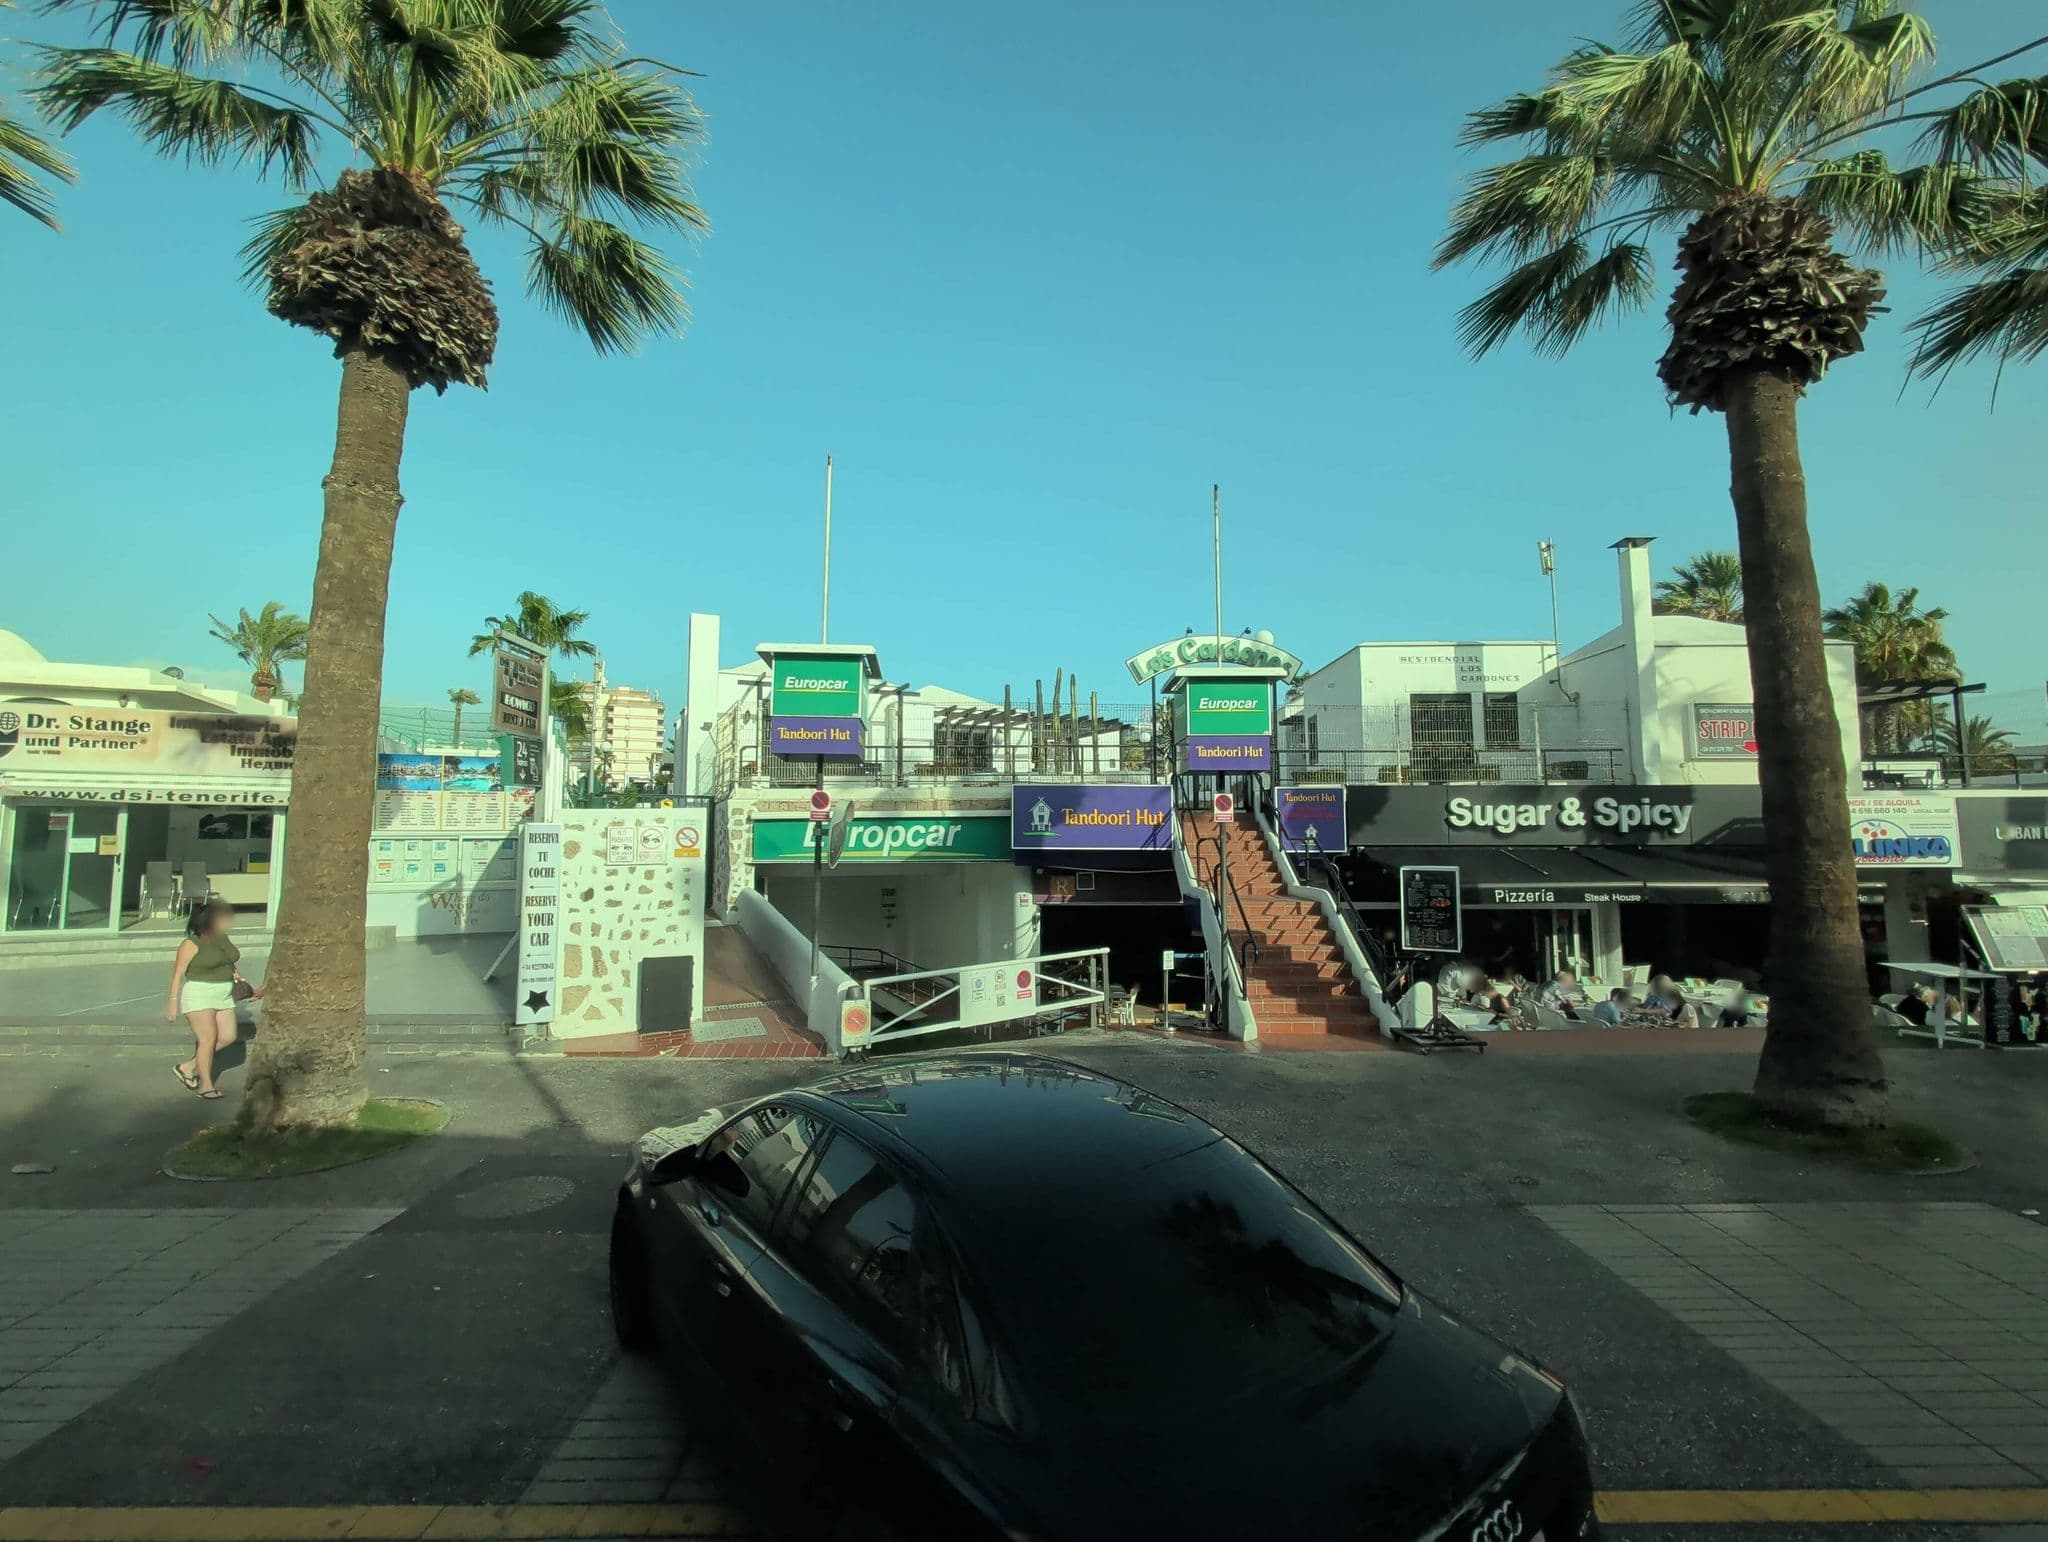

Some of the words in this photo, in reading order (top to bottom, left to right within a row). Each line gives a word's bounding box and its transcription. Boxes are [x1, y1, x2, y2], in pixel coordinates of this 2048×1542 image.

[1132, 650, 1175, 681] Los
[784, 676, 848, 692] Europcar
[1199, 697, 1258, 712] Europcar
[27, 713, 60, 729] Dr.
[69, 715, 152, 735] Stange
[1699, 719, 1749, 739] STRIP
[777, 727, 827, 740] Tandoori
[830, 729, 851, 741] Hut
[25, 736, 60, 747] und
[69, 737, 138, 750] Partner
[517, 741, 528, 758] 24
[1196, 746, 1241, 757] Tandoori
[1244, 746, 1264, 757] Hut
[23, 790, 291, 803] www.dsi-tenerife.
[1284, 792, 1320, 802] Tandoori
[1321, 793, 1336, 802] Hut
[1062, 807, 1130, 826] Tandoori
[1136, 808, 1165, 826] Hut
[1448, 797, 1551, 833] Sugar
[1559, 797, 1586, 827] &
[1593, 797, 1693, 833] Spicy
[528, 832, 560, 844] RESERVA
[538, 851, 549, 862] TU
[529, 867, 556, 879] COCHE
[525, 895, 558, 907] RESERVE
[1494, 889, 1555, 903] Pizzería
[1584, 893, 1610, 902] Steak
[1612, 893, 1641, 902] House
[527, 912, 554, 927] YOUR
[530, 932, 549, 947] CAR
